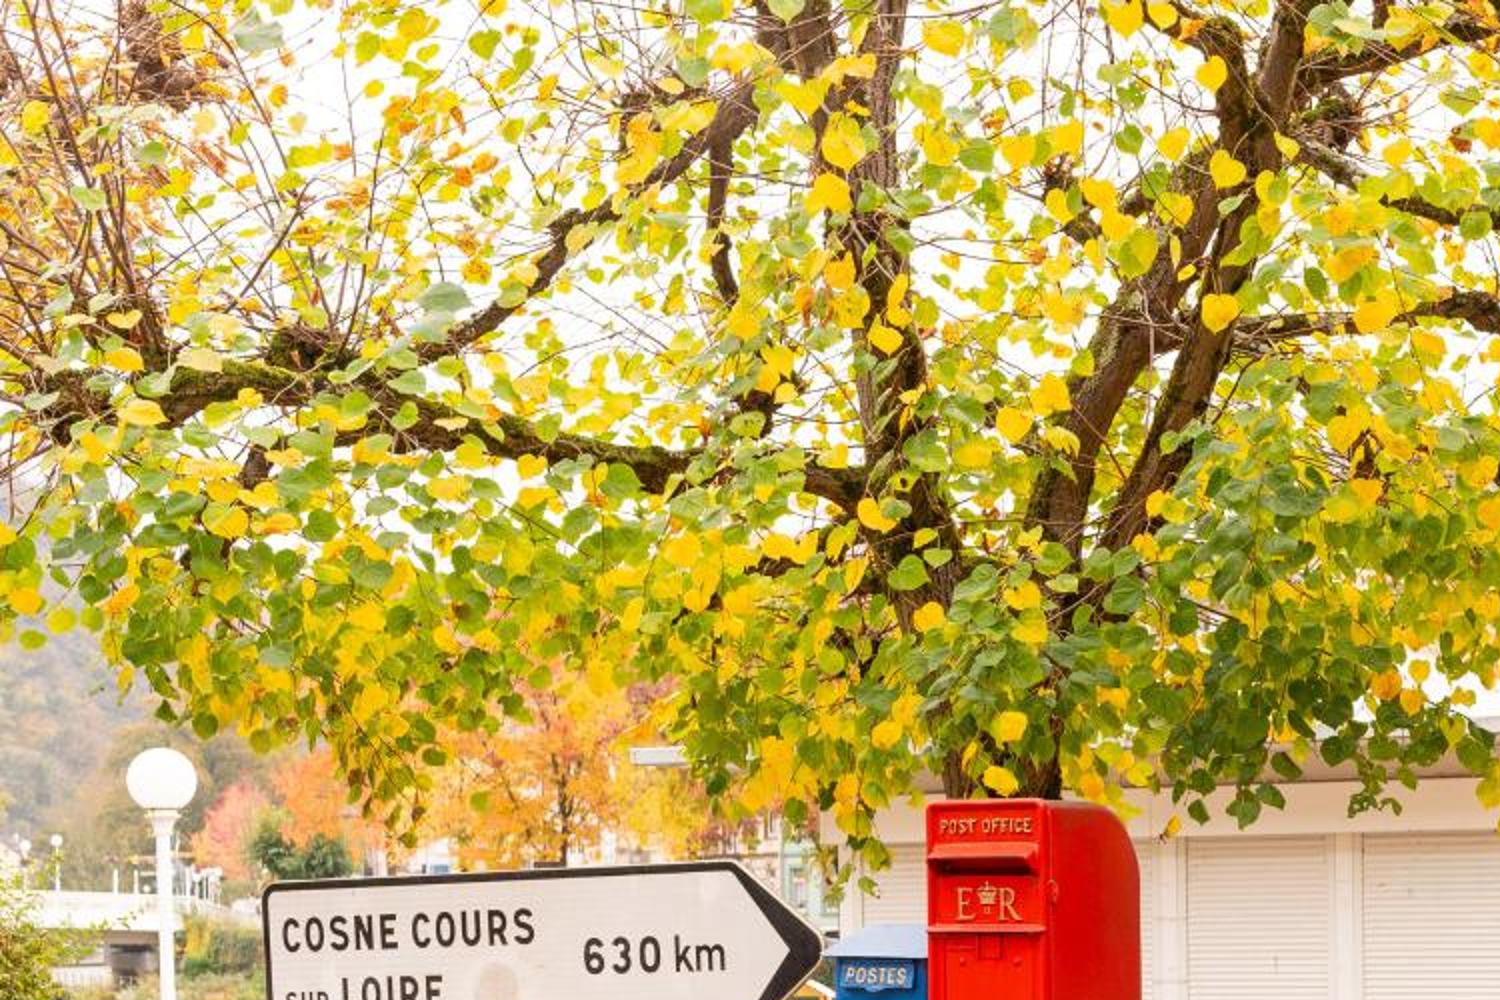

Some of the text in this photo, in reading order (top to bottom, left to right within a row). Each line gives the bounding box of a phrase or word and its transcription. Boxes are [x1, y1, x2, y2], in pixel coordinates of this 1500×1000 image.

[939, 817, 1033, 833] POST OFFICE
[282, 907, 535, 953] COSNE COURS
[583, 934, 726, 975] 630 km
[845, 966, 908, 985] POSTES
